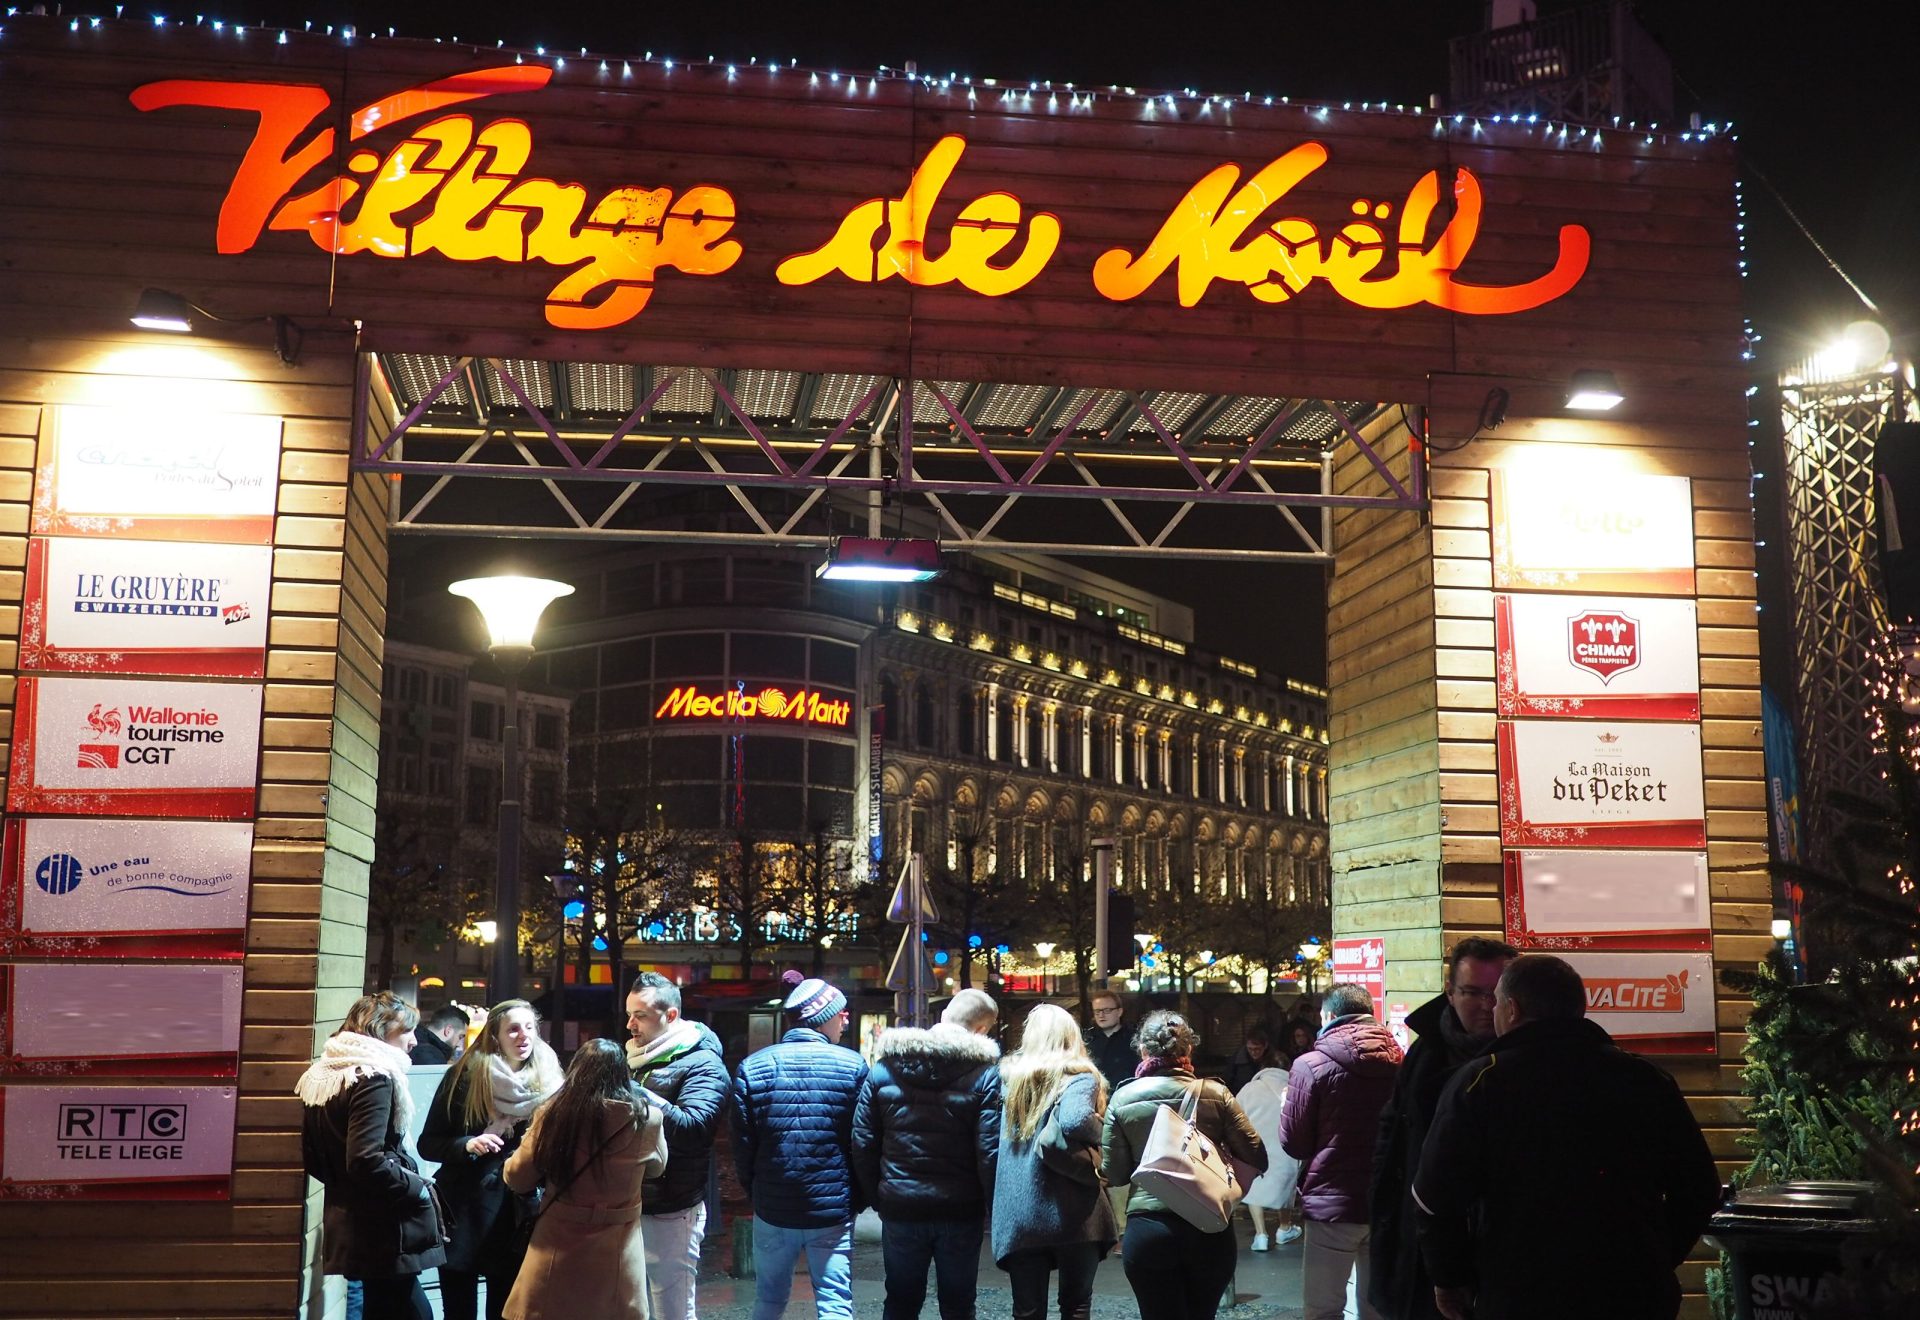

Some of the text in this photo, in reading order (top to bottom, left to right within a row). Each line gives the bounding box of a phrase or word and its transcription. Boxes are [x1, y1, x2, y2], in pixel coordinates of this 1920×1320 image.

[128, 64, 1591, 330] Village de Noël
[76, 572, 221, 602] LE GRUYÈRE
[79, 602, 214, 616] SWITZERLAND
[1576, 643, 1635, 657] CHIMAY
[127, 706, 219, 726] Wallonie
[655, 686, 850, 726] Media Markt
[127, 725, 224, 744] tourisme
[124, 746, 175, 765] CGT
[1568, 761, 1651, 777] La Maison
[1553, 775, 1667, 807] du Peket
[869, 792, 882, 838] GALERIES
[89, 856, 150, 876] Une eau
[107, 871, 233, 888] de bonne compagnie
[64, 1106, 180, 1138] RTC
[57, 1145, 183, 1160] TELE LIEGE
